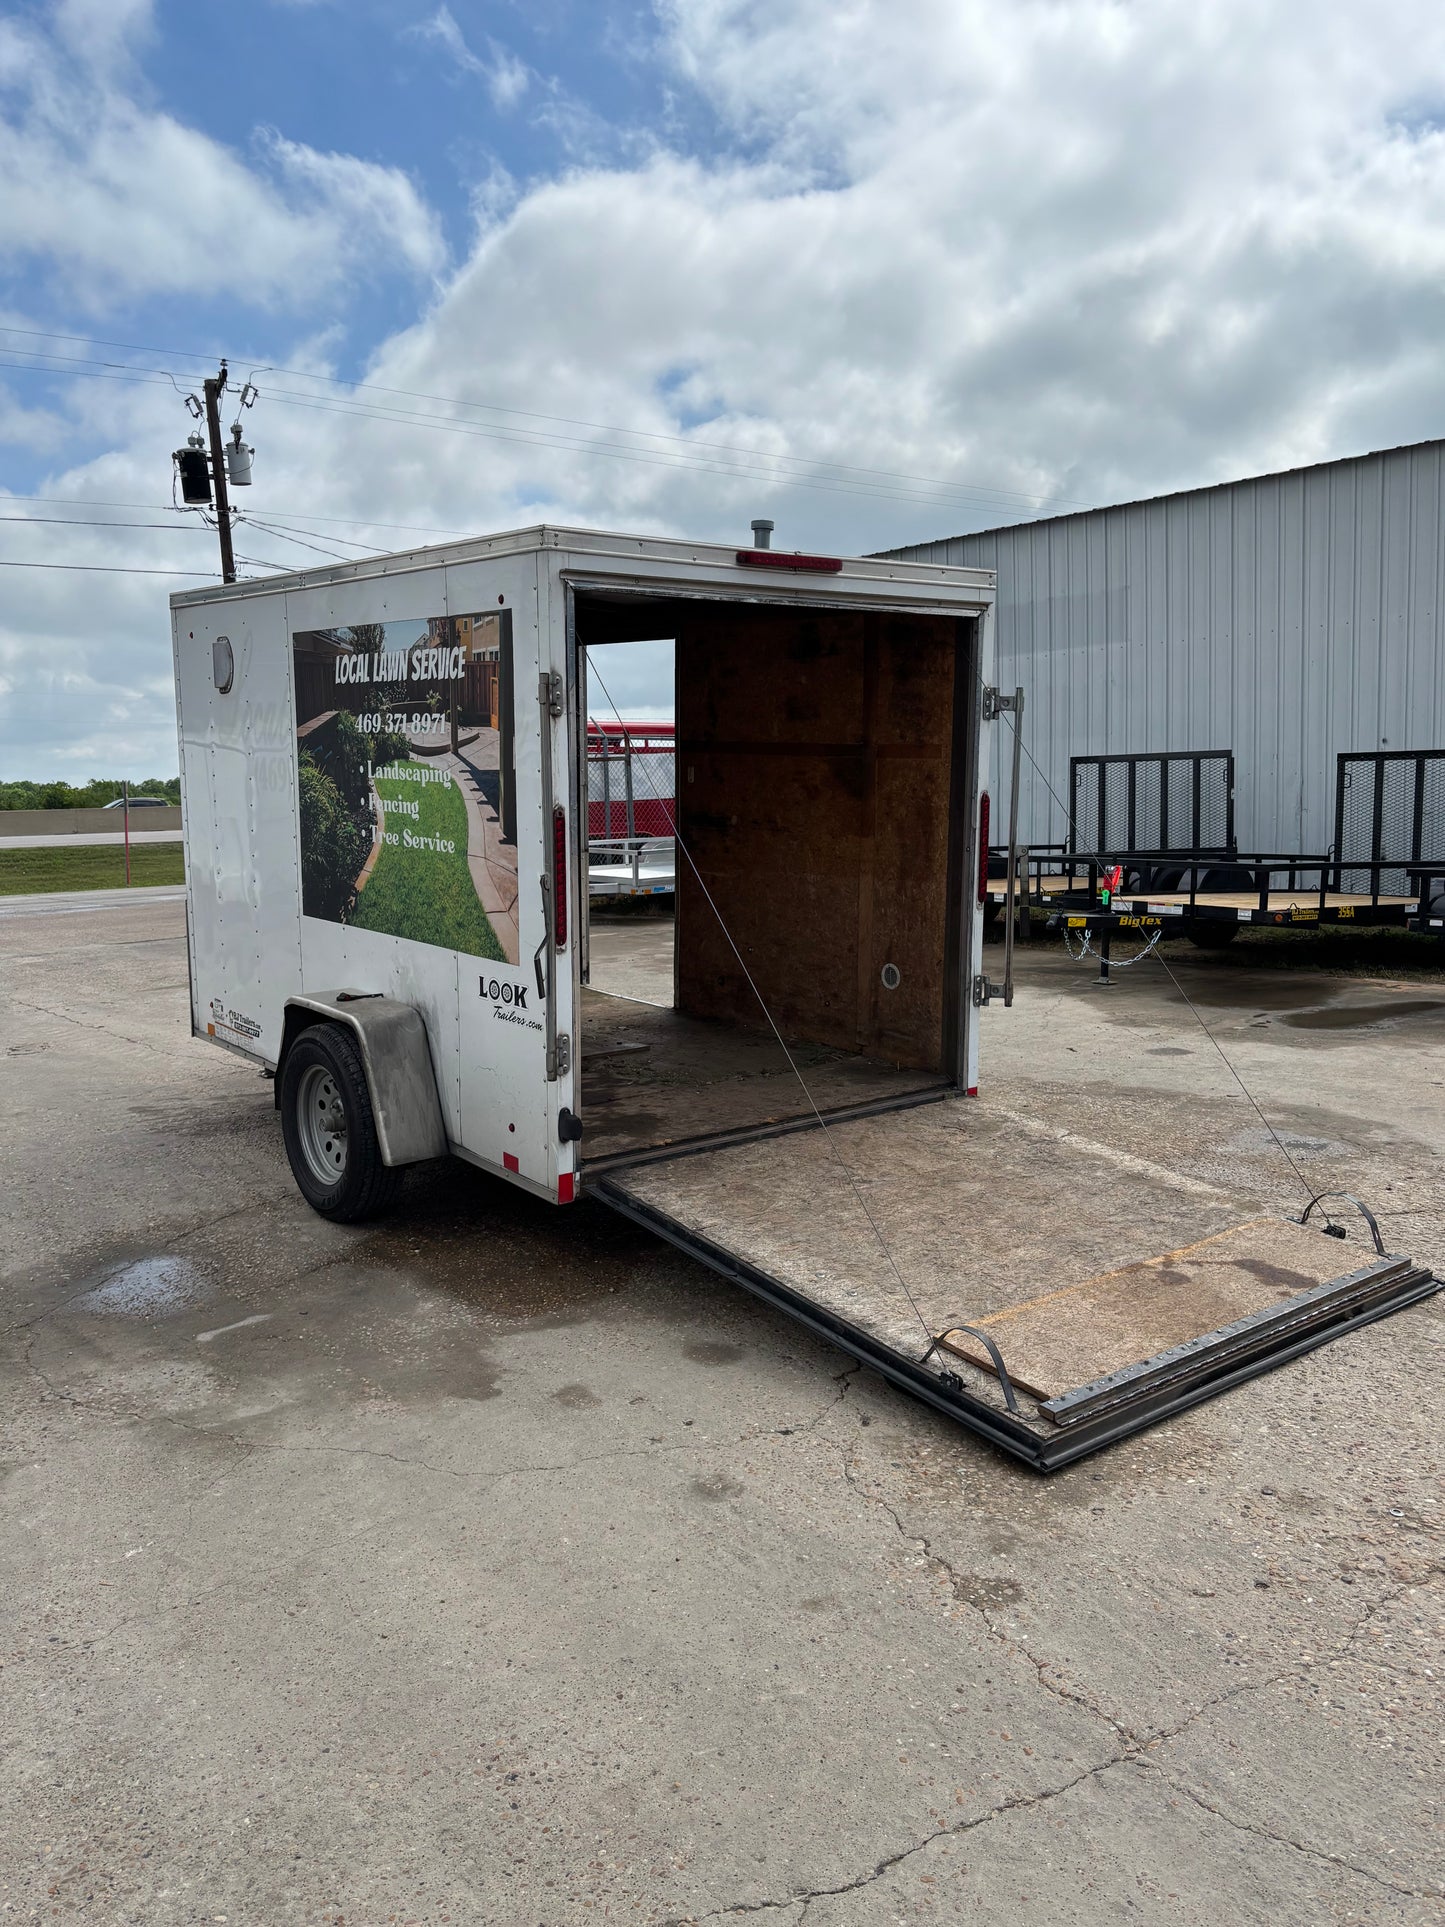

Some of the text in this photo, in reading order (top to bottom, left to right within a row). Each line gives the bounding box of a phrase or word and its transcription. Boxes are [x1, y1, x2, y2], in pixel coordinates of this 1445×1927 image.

[335, 645, 467, 685] LOCAL LAWN SERVICE
[354, 712, 447, 735] 469-371-8971
[367, 759, 452, 790] Landscaping
[368, 792, 420, 821] Fencing
[369, 824, 456, 854] Tree Service
[1119, 915, 1163, 928] BigTex
[478, 975, 529, 1009] LOOK
[493, 1005, 544, 1032] Trailers.com
